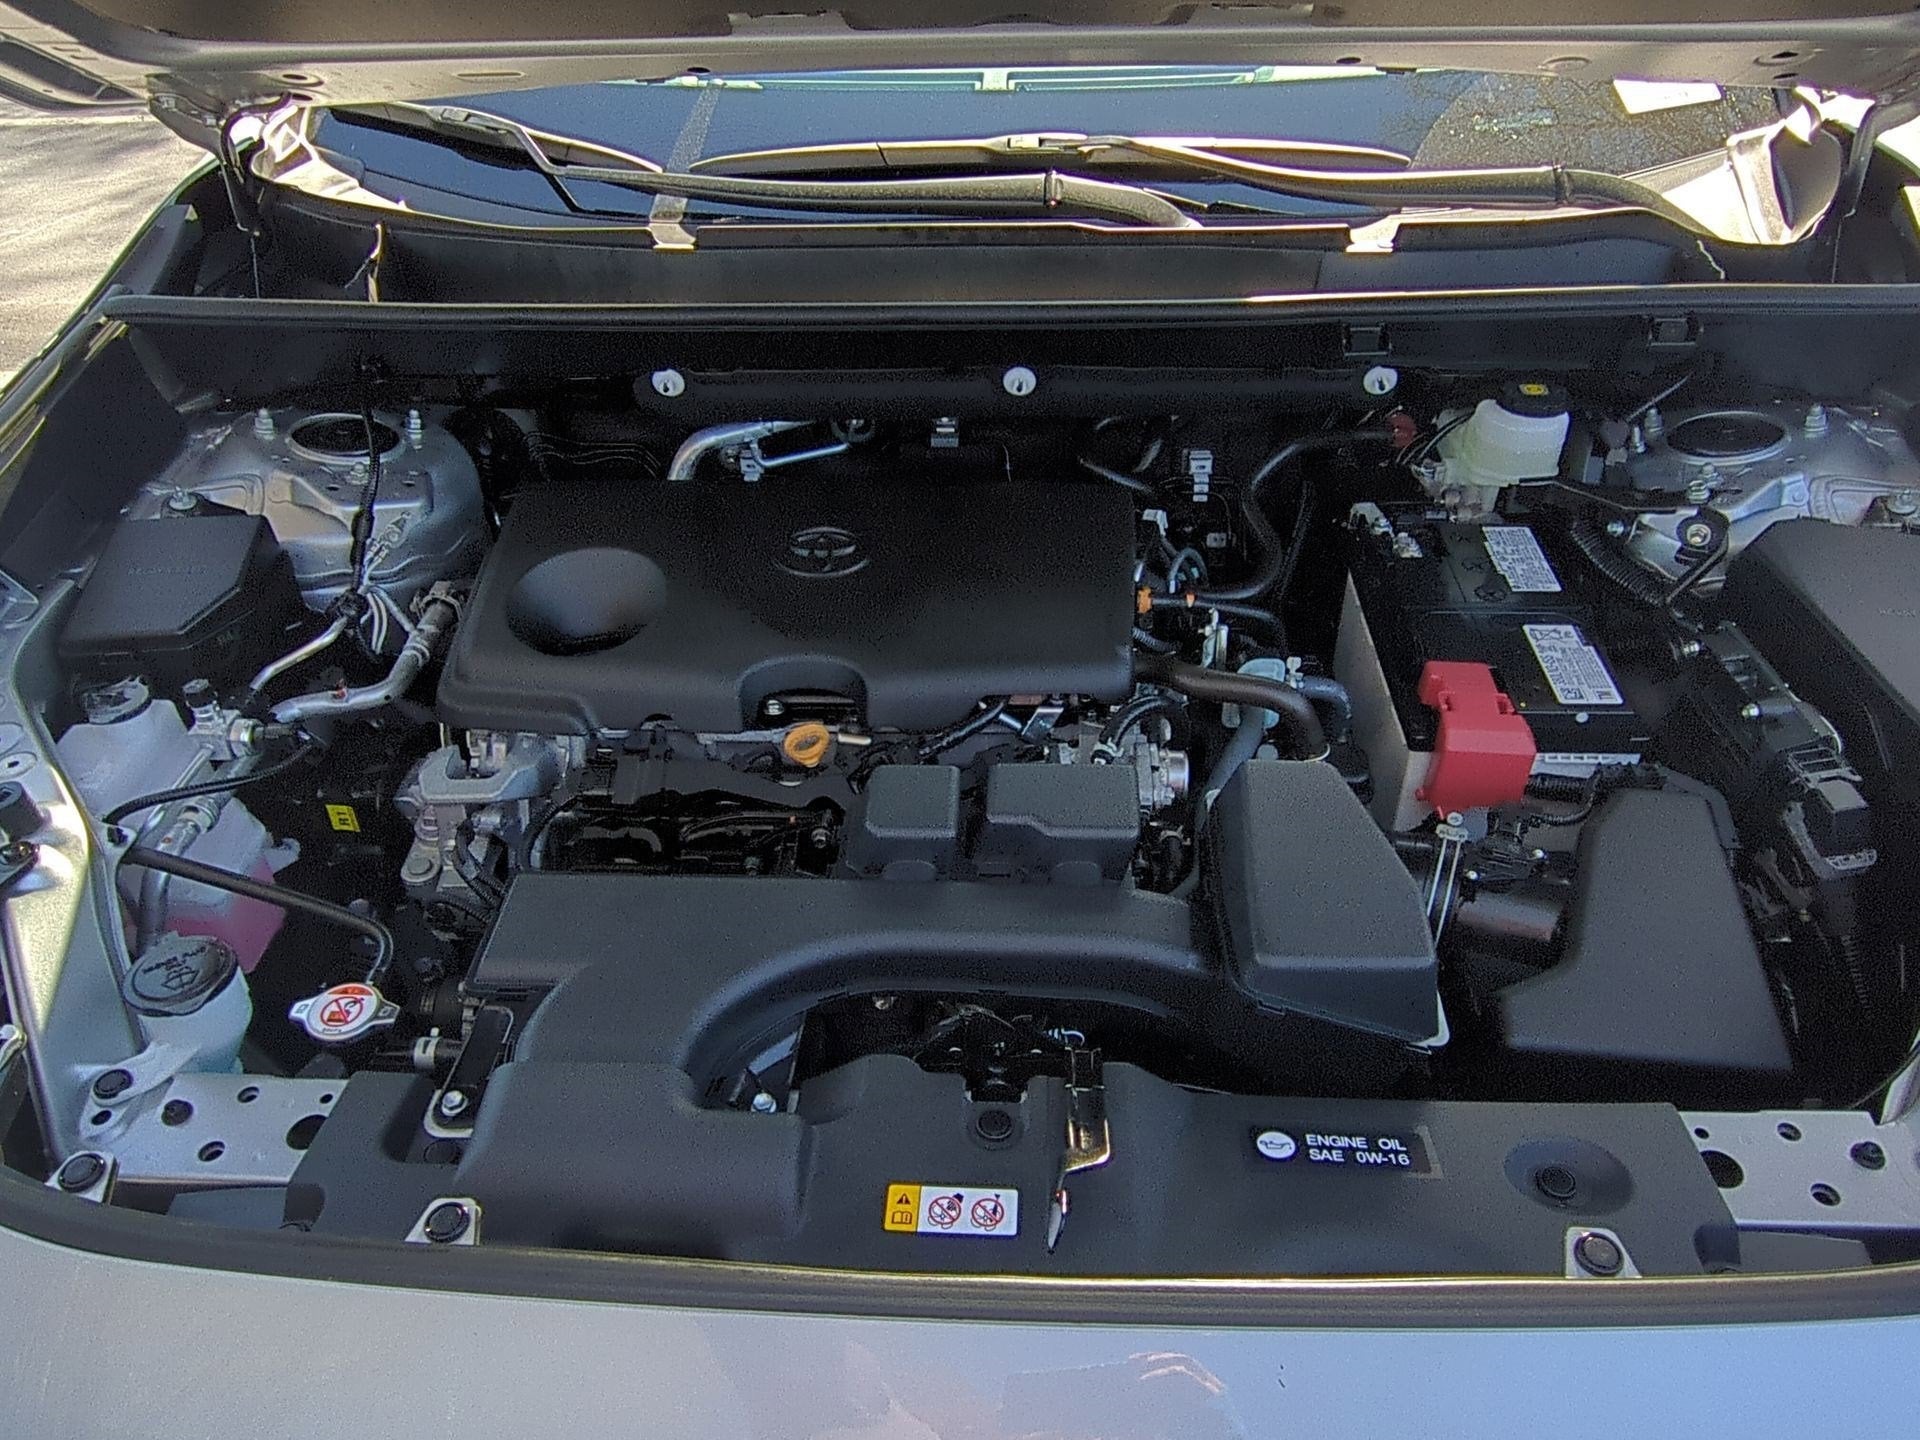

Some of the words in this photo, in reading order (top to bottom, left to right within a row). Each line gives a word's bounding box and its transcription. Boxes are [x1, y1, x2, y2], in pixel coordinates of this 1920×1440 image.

[1305, 1133, 1368, 1149] ENGINE
[1378, 1137, 1407, 1151] OIL
[1309, 1148, 1345, 1162] SAE
[1356, 1151, 1410, 1166] 0W-16
